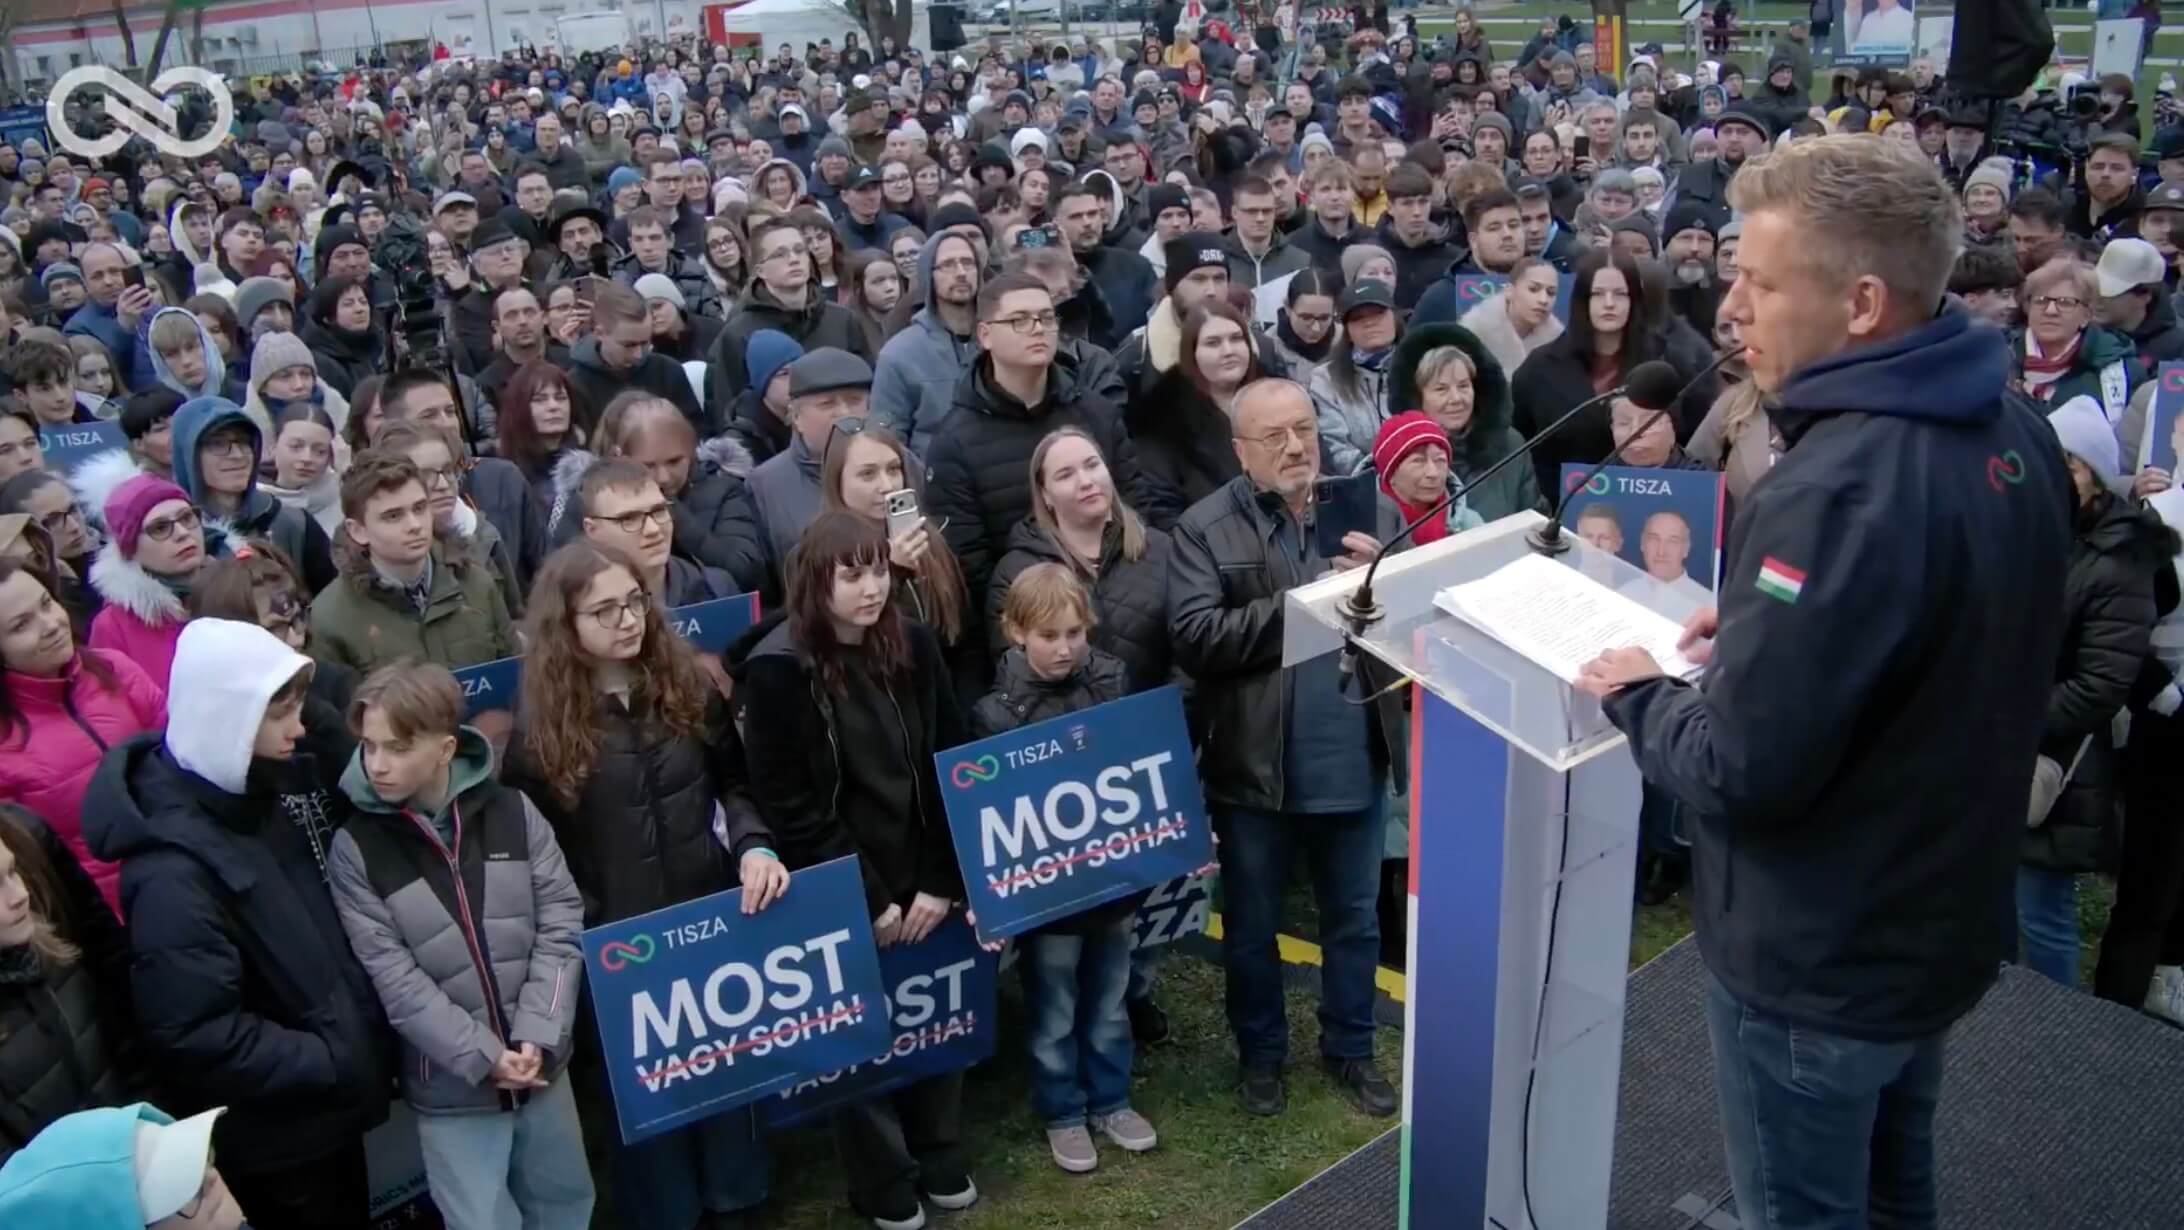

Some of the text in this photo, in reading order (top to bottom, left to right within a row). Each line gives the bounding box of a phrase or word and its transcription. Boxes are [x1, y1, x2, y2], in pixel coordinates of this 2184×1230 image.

[56, 431, 103, 447] TISZA
[1617, 477, 1672, 495] TISZA
[1005, 739, 1063, 769] TISZA
[980, 751, 1172, 867] MOST
[986, 811, 1187, 898] VAGY SOHA!
[662, 916, 728, 949] TISZA
[632, 928, 850, 1059] MOST
[884, 958, 975, 1027] ST
[635, 1034, 739, 1093] VAGY
[750, 994, 863, 1057] SOHA!
